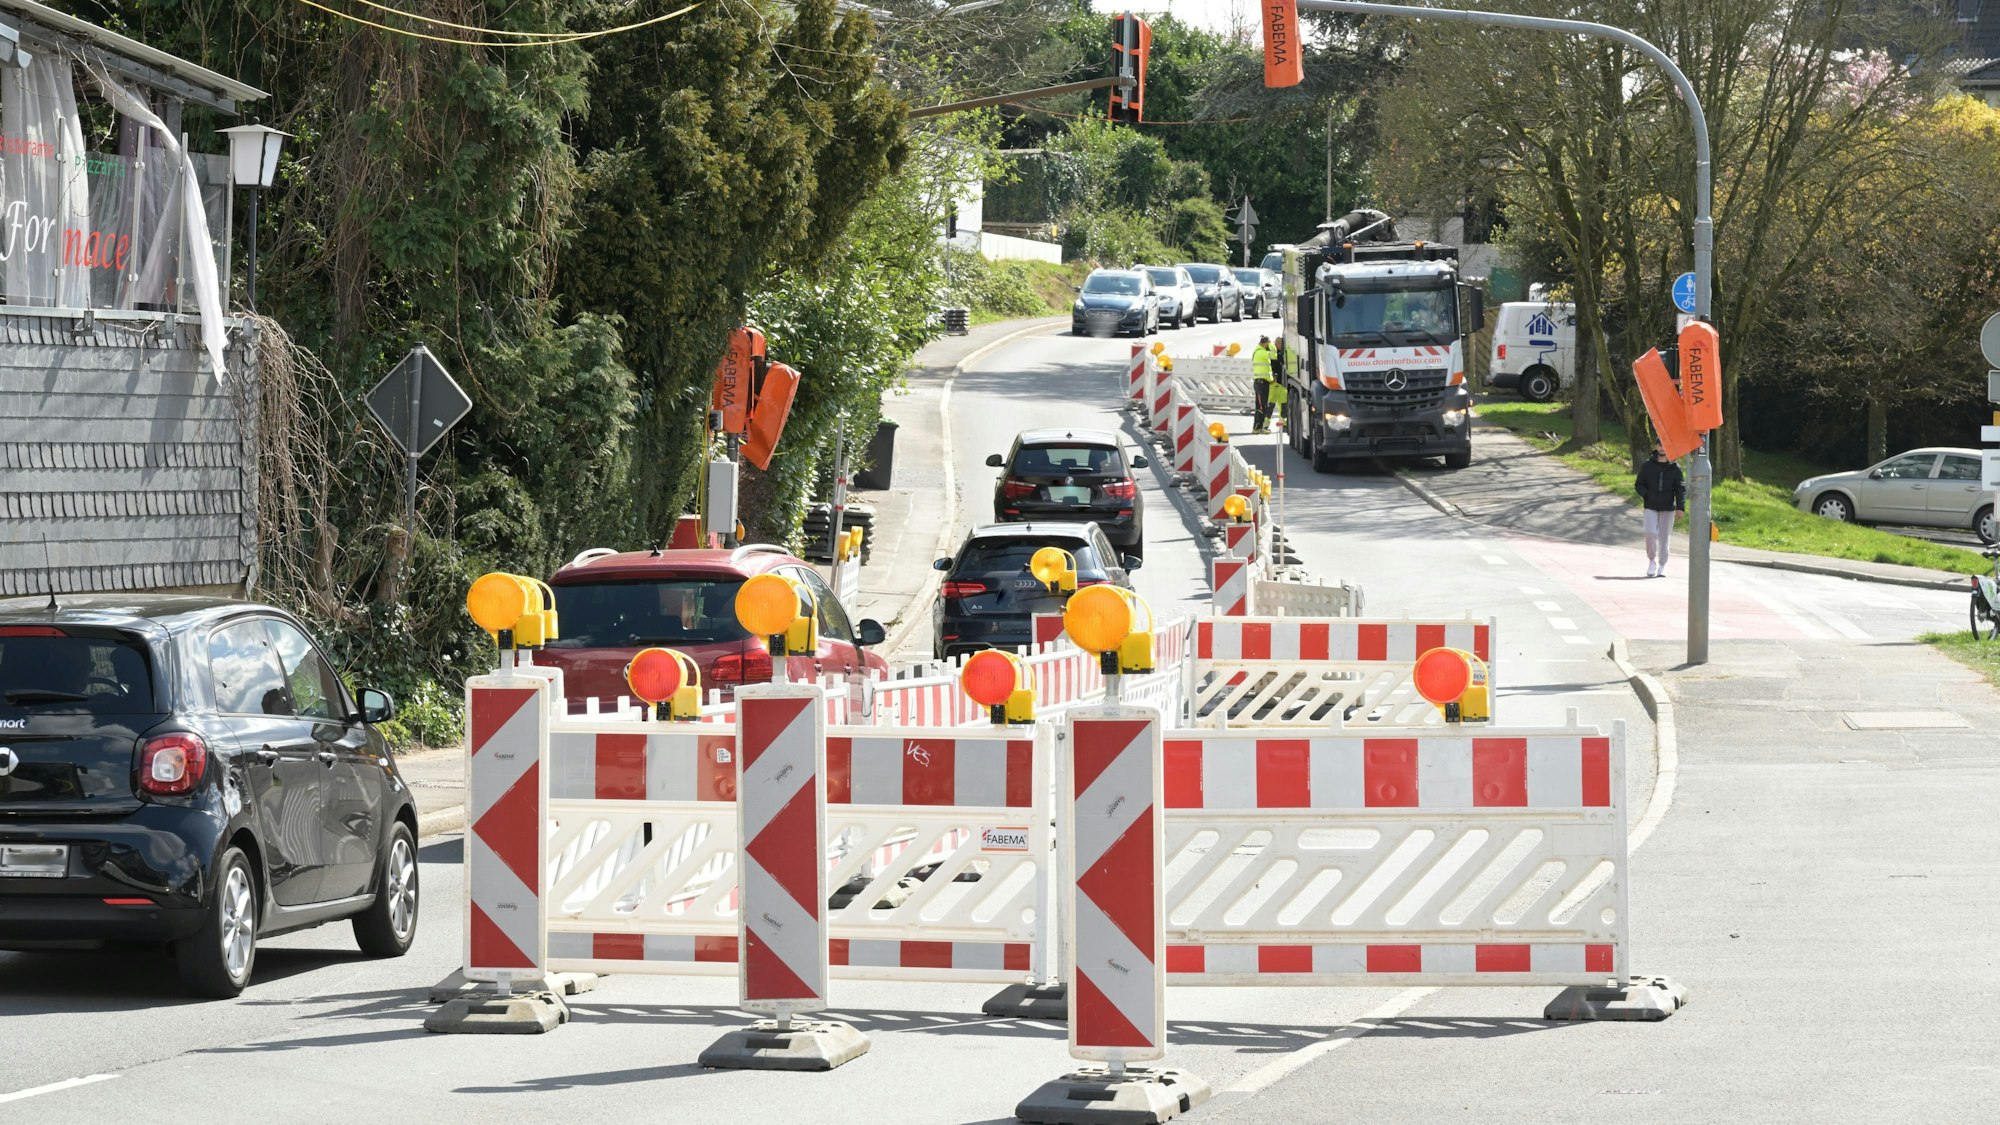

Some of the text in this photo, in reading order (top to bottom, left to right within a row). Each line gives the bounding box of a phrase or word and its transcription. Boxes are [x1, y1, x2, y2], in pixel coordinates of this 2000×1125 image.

[1271, 6, 1287, 66] FABEMA
[0, 134, 54, 158] istorante
[723, 351, 738, 407] FABEMA
[1689, 348, 1704, 405] FABEMA
[0, 718, 26, 729] mart
[986, 834, 1026, 845] FABEMA
